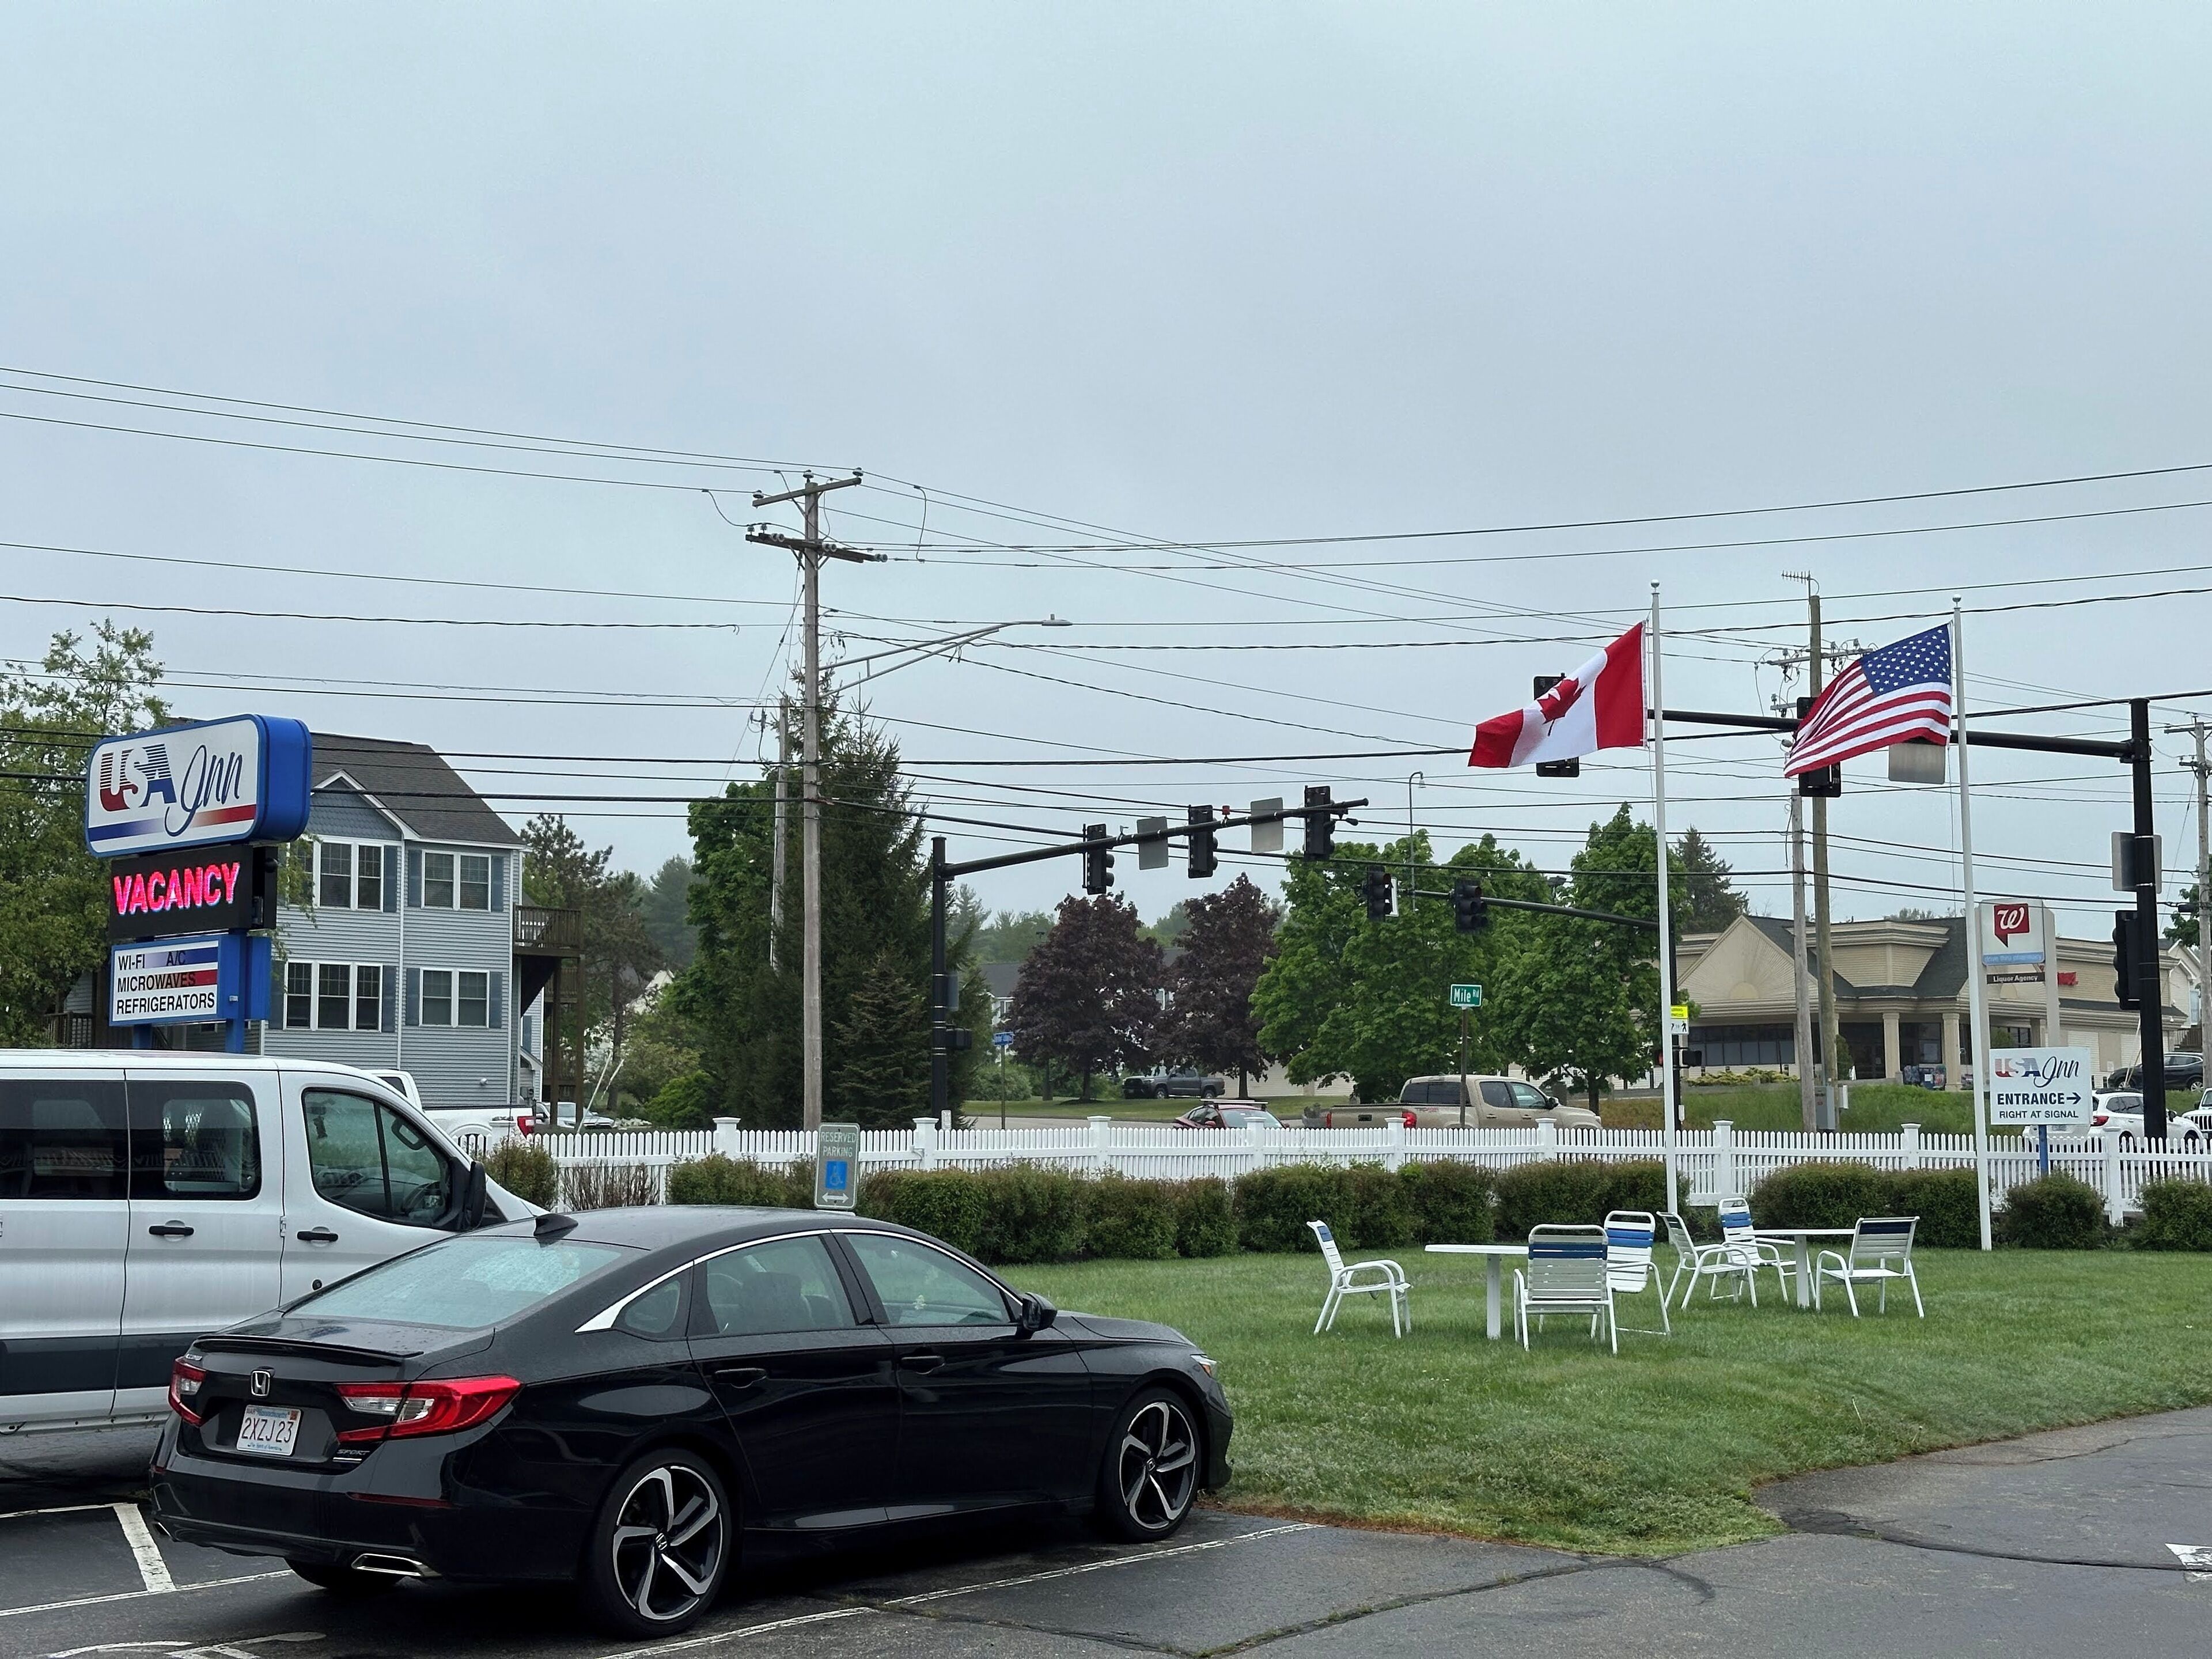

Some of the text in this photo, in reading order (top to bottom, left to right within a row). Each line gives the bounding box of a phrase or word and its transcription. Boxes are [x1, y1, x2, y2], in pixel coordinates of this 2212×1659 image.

[100, 743, 243, 836] USA Inn
[113, 862, 240, 916] VACANCY
[118, 950, 186, 971] WI-FI A/C
[118, 972, 196, 993] MICROWAVES
[116, 993, 215, 1014] REFRIGERATORS
[1454, 988, 1471, 1002] Mile
[1994, 1056, 2079, 1088] USA Inn
[1997, 1092, 2065, 1105] ENTRANCE
[1999, 1111, 2028, 1119] RIGHT
[2044, 1110, 2079, 1118] SIGNAL
[821, 1131, 857, 1143] RESERVED
[823, 1146, 853, 1157] PARKING
